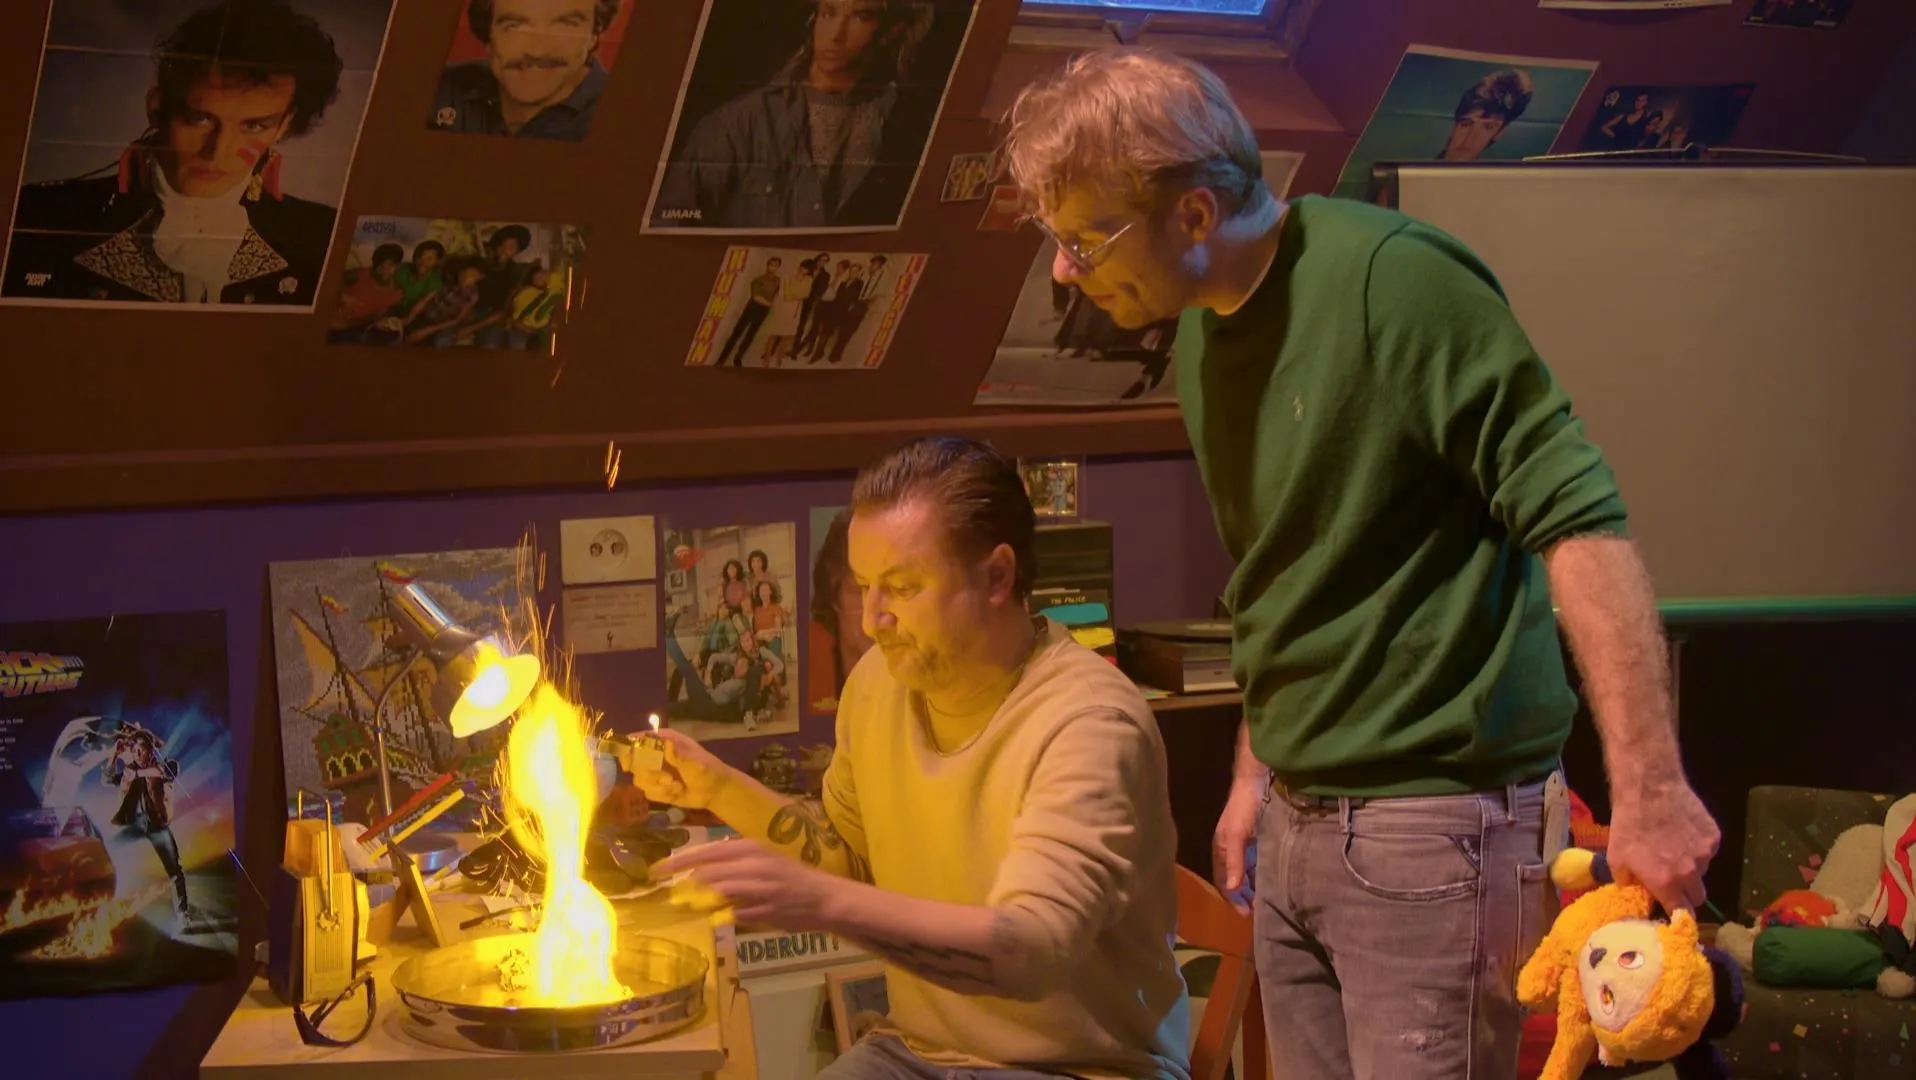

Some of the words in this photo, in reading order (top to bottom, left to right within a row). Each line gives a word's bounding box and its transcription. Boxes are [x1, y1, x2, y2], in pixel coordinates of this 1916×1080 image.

[662, 208, 702, 219] LIMAHL
[687, 248, 748, 366] HUMAN
[863, 255, 926, 367] LEAGUE
